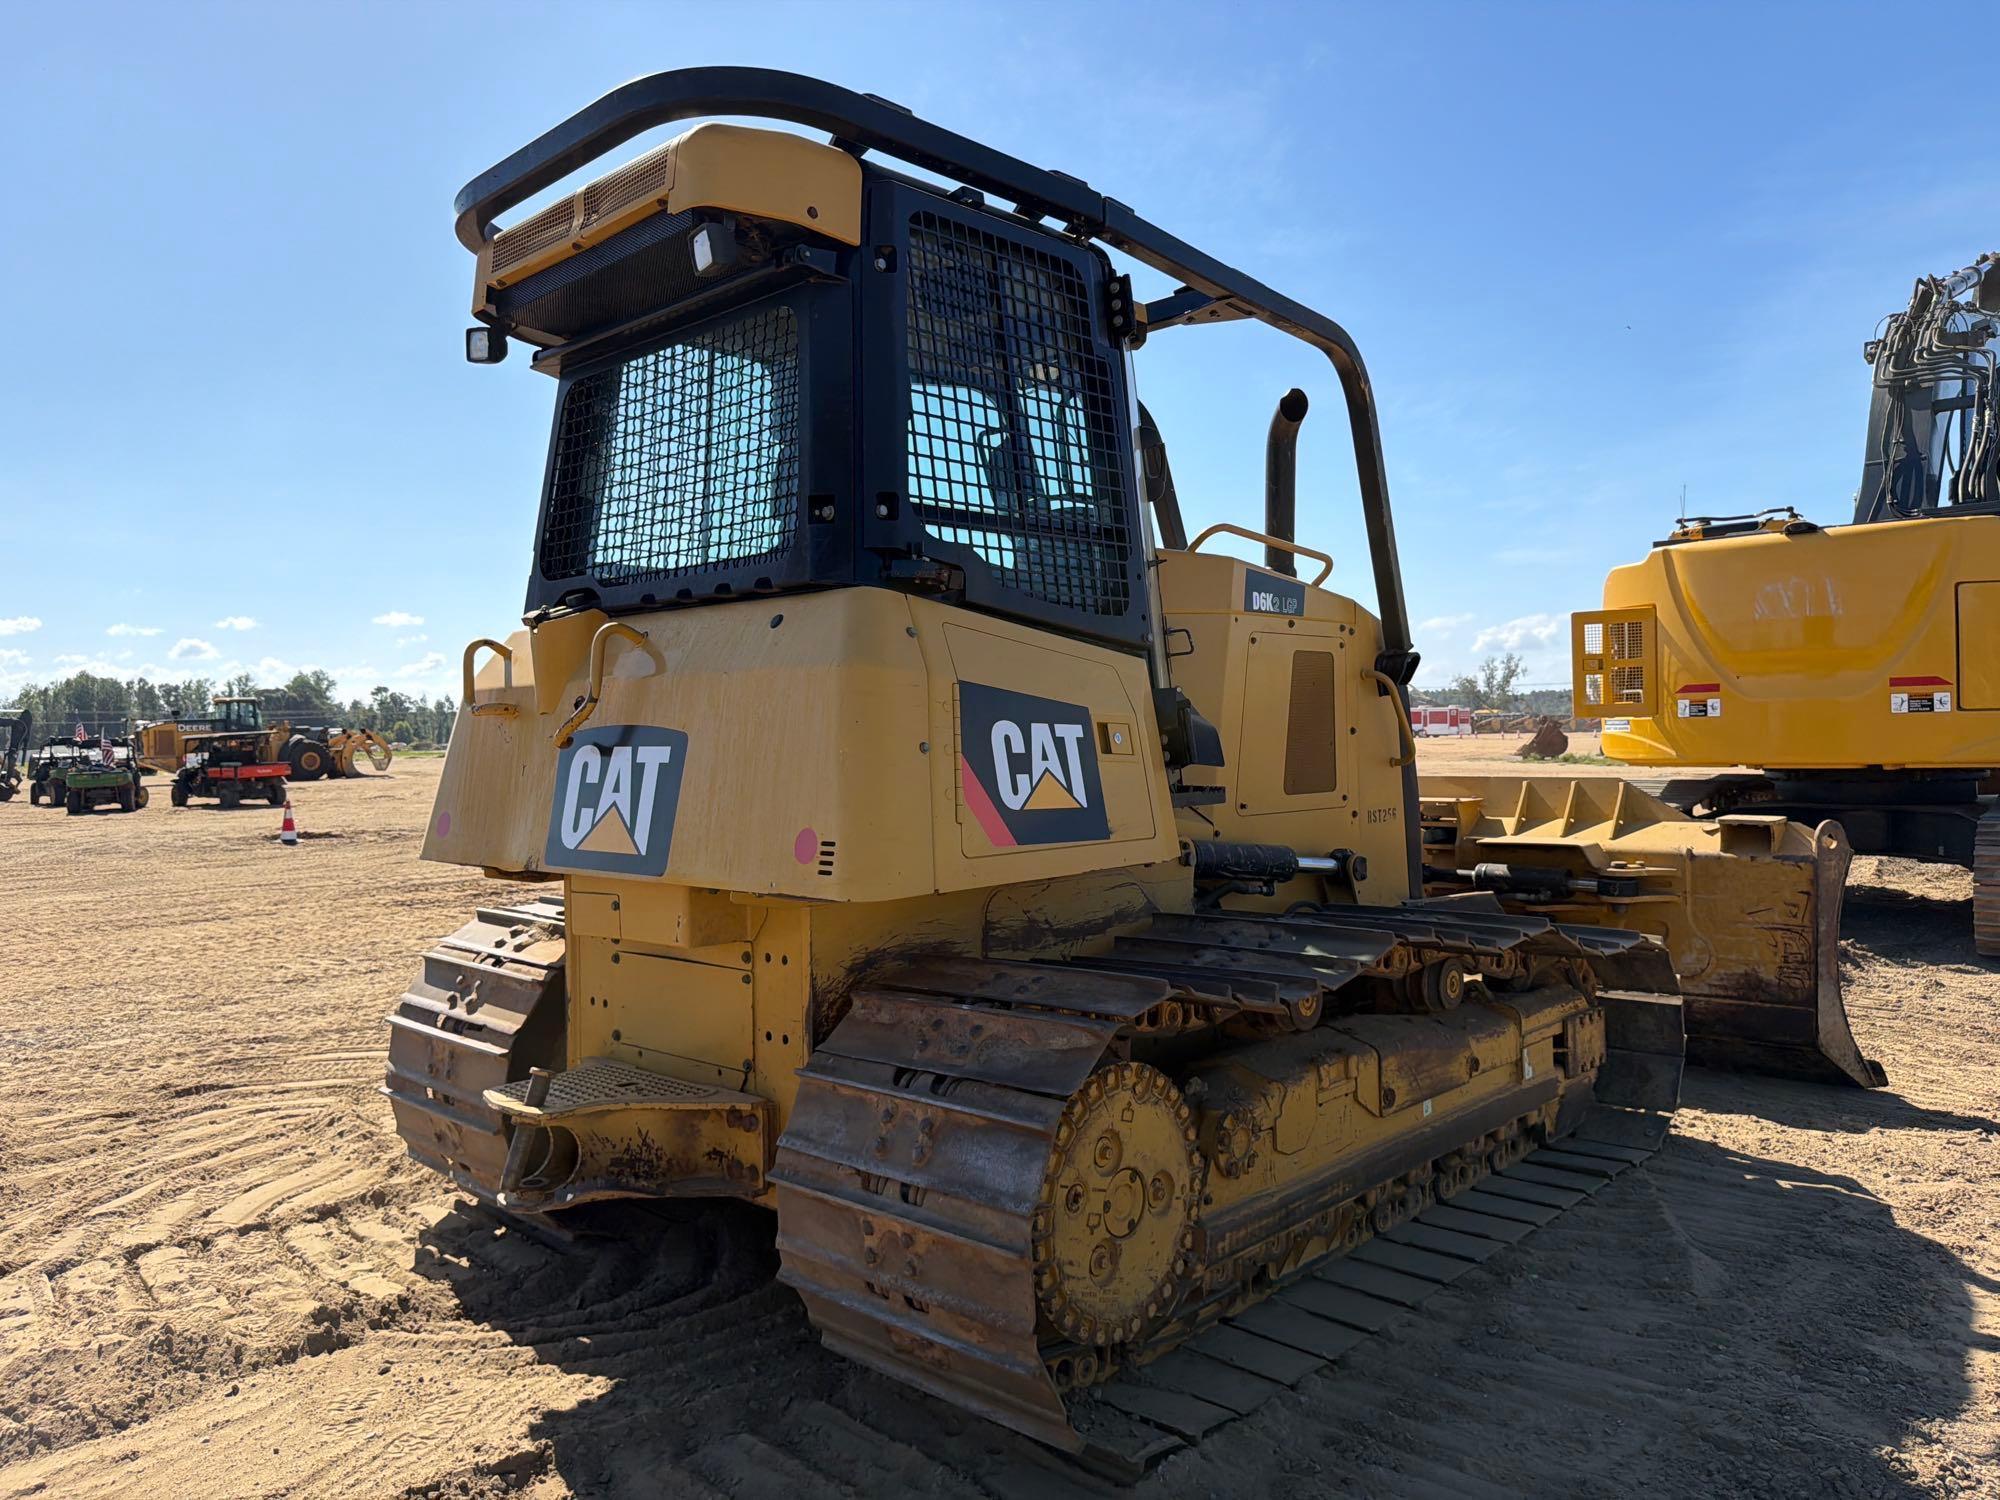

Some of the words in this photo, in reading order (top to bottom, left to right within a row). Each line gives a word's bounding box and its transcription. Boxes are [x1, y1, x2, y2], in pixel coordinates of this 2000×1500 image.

[178, 723, 212, 732] DEERE
[989, 719, 1088, 811] CAT
[561, 744, 671, 856] CAT
